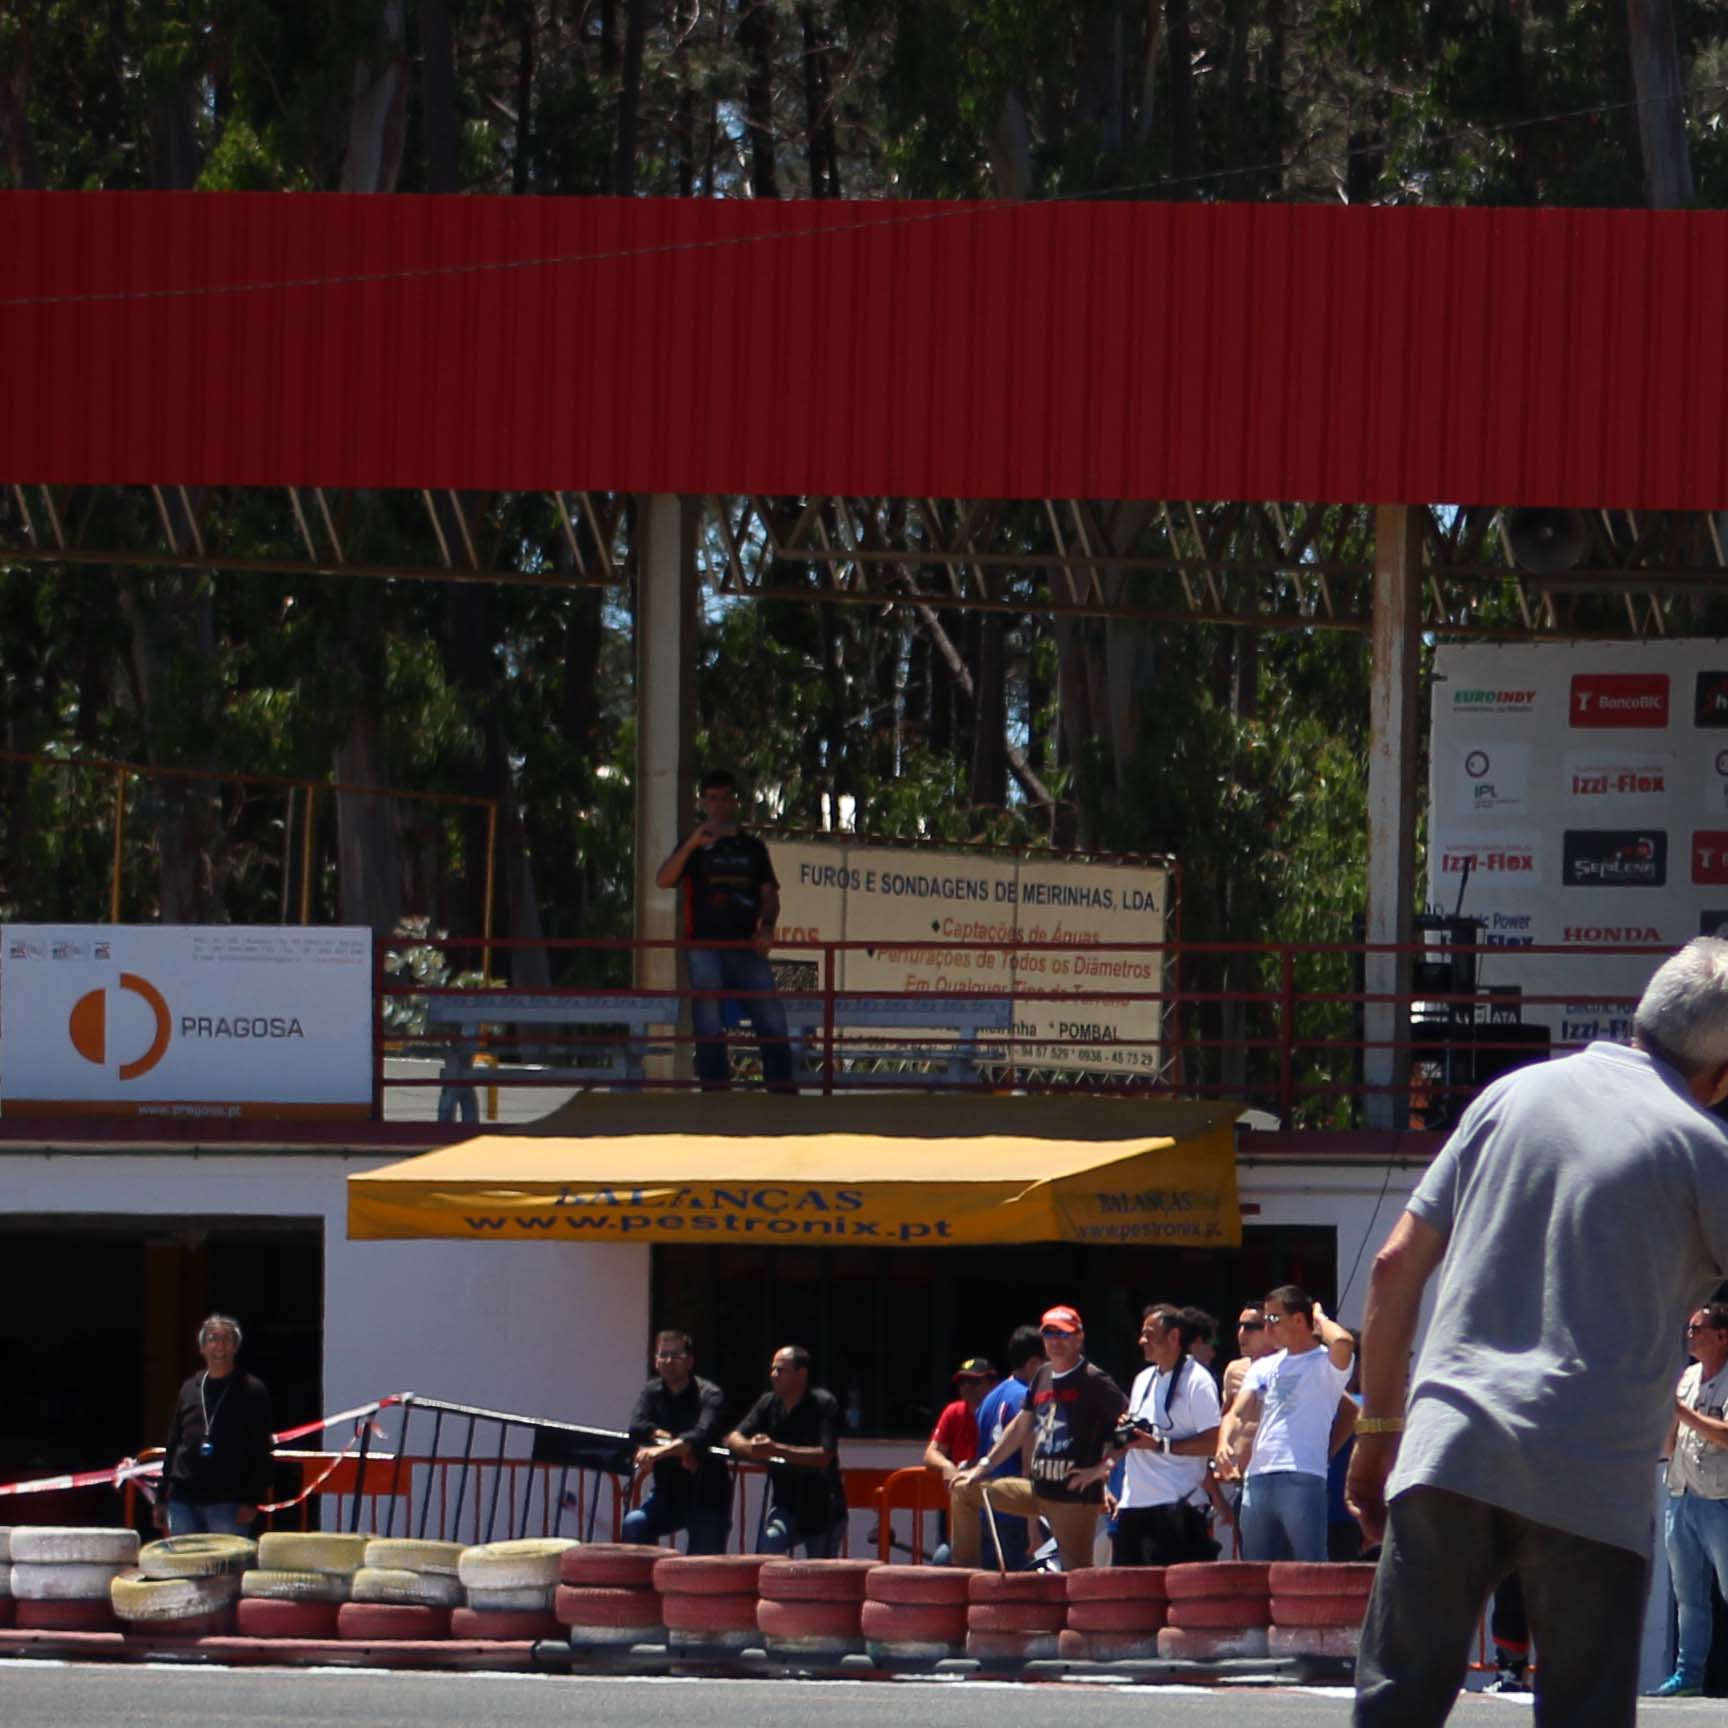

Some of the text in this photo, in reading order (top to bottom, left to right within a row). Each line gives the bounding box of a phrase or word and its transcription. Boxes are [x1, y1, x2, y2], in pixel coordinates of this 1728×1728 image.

[1454, 689, 1537, 704] EUROINDY
[1572, 772, 1665, 795] Izzi-Flex
[800, 862, 1160, 913] FUROS E SONDAGENS DE MEIRINHAS, LDA.
[942, 917, 1024, 942] Captações
[1029, 921, 1048, 943] de
[1493, 912, 1531, 929] Power
[1563, 926, 1662, 942] HONDA
[975, 949, 996, 969] de
[1001, 950, 1047, 974] Todos
[1052, 956, 1070, 975] os
[1074, 949, 1152, 980] Diâmetros
[181, 1016, 304, 1039] PRAGOSA
[464, 1213, 951, 1241] www.pestronix.pt
